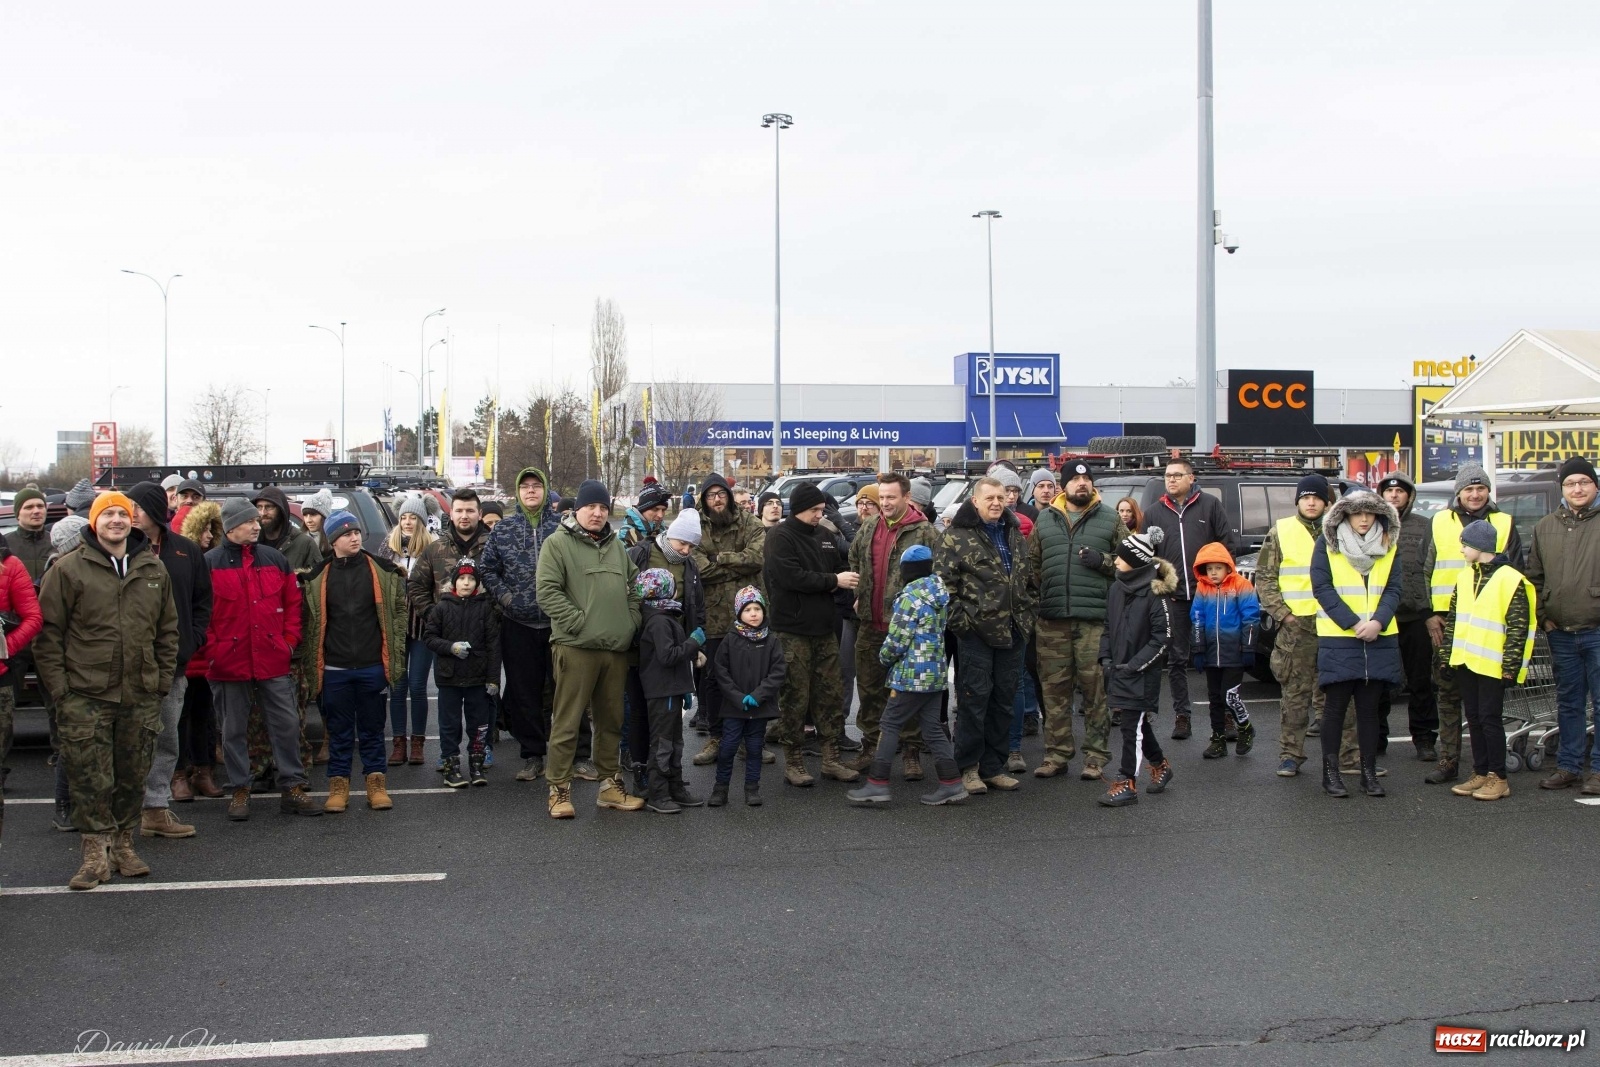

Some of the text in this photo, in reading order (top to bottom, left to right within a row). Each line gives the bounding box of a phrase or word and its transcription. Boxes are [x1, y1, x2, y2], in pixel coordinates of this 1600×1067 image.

[1413, 354, 1481, 377] medi
[994, 367, 1050, 385] JYSK
[1238, 382, 1306, 409] CCC
[707, 427, 899, 442] Scandinavin Sleeping & Living
